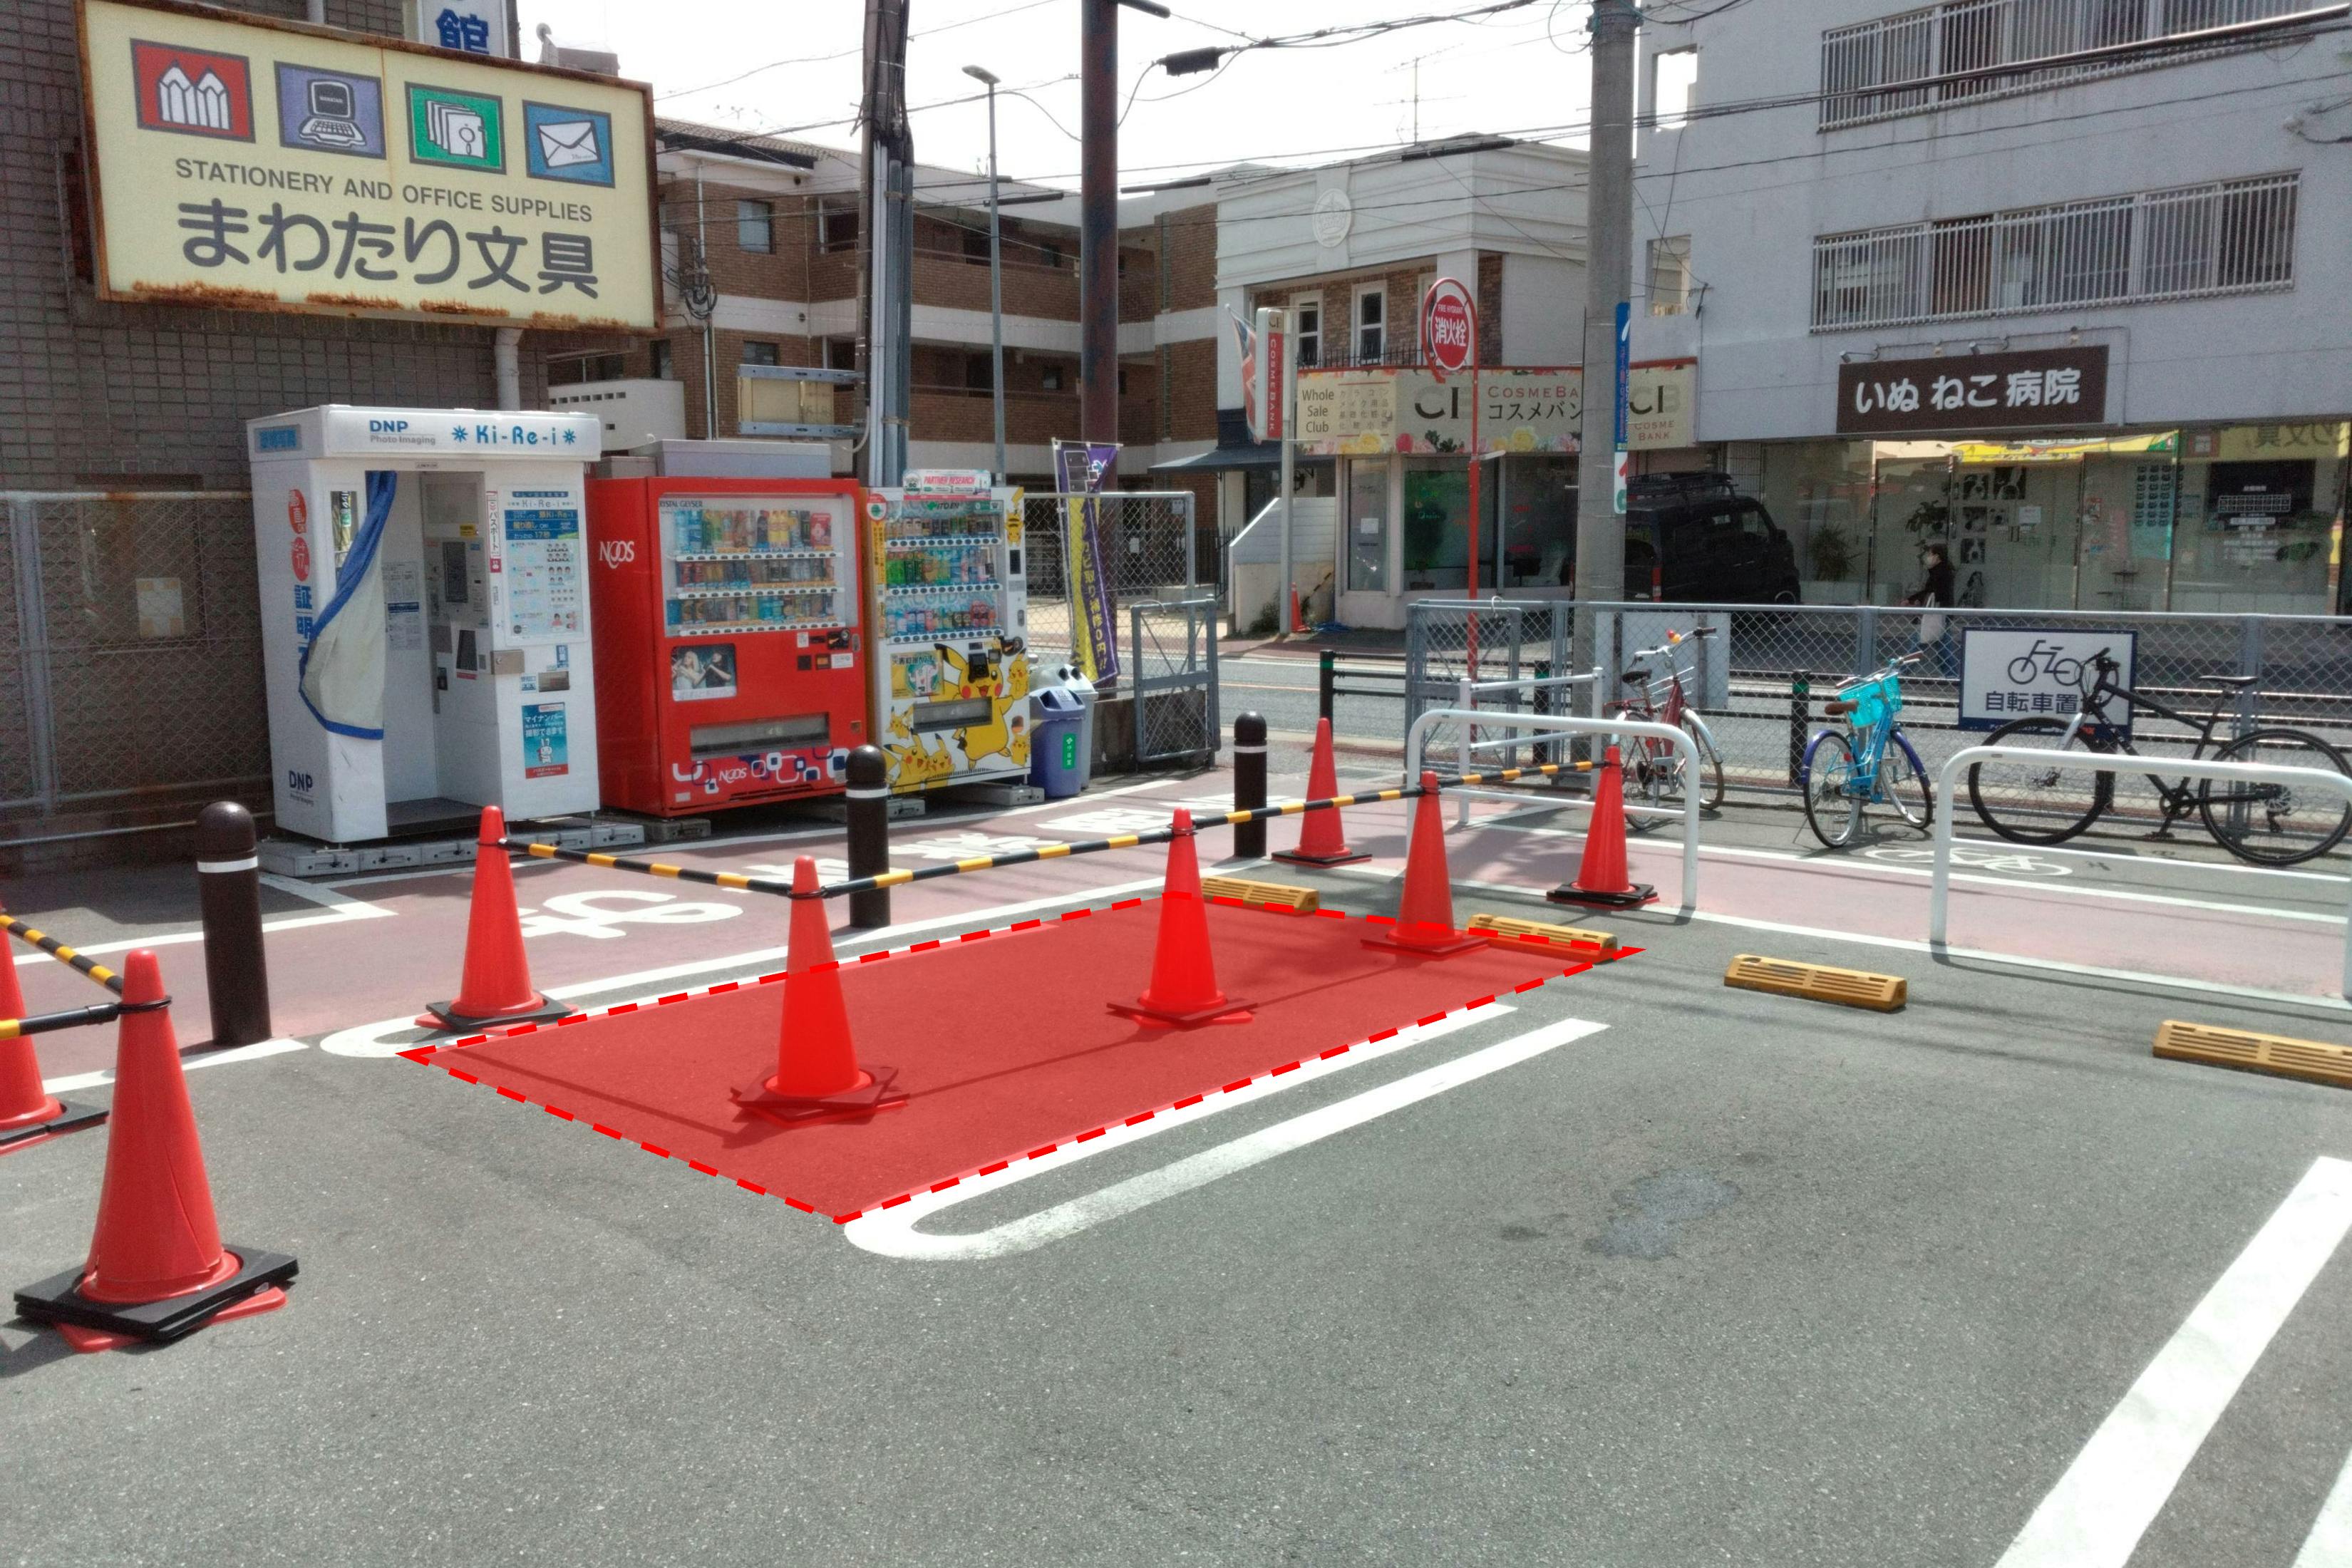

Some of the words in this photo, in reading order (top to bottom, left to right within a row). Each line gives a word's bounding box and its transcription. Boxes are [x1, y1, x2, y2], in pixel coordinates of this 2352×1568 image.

[435, 9, 490, 54] 館
[175, 158, 334, 195] STATIONERY
[343, 179, 393, 201] AND
[401, 185, 483, 211] OFFICE
[490, 195, 593, 223] SUPPLIES
[177, 197, 599, 300] まわたり文具
[1435, 316, 1467, 347] 消火栓
[1302, 389, 1335, 401] Whole
[1487, 386, 1579, 398] COSMEBA
[1855, 378, 1919, 413] いぬ
[1931, 375, 1998, 411] ねこ
[2006, 368, 2081, 407] 病院
[1307, 406, 1329, 417] Sale
[1488, 401, 1582, 421] コスメバン
[369, 420, 408, 433] DNP
[1306, 421, 1330, 433] Club
[1639, 432, 1671, 441] BANK
[370, 435, 397, 444] Photo
[398, 435, 436, 445] Imaging
[1985, 689, 2080, 713] 自転車置
[289, 770, 313, 792] DNP
